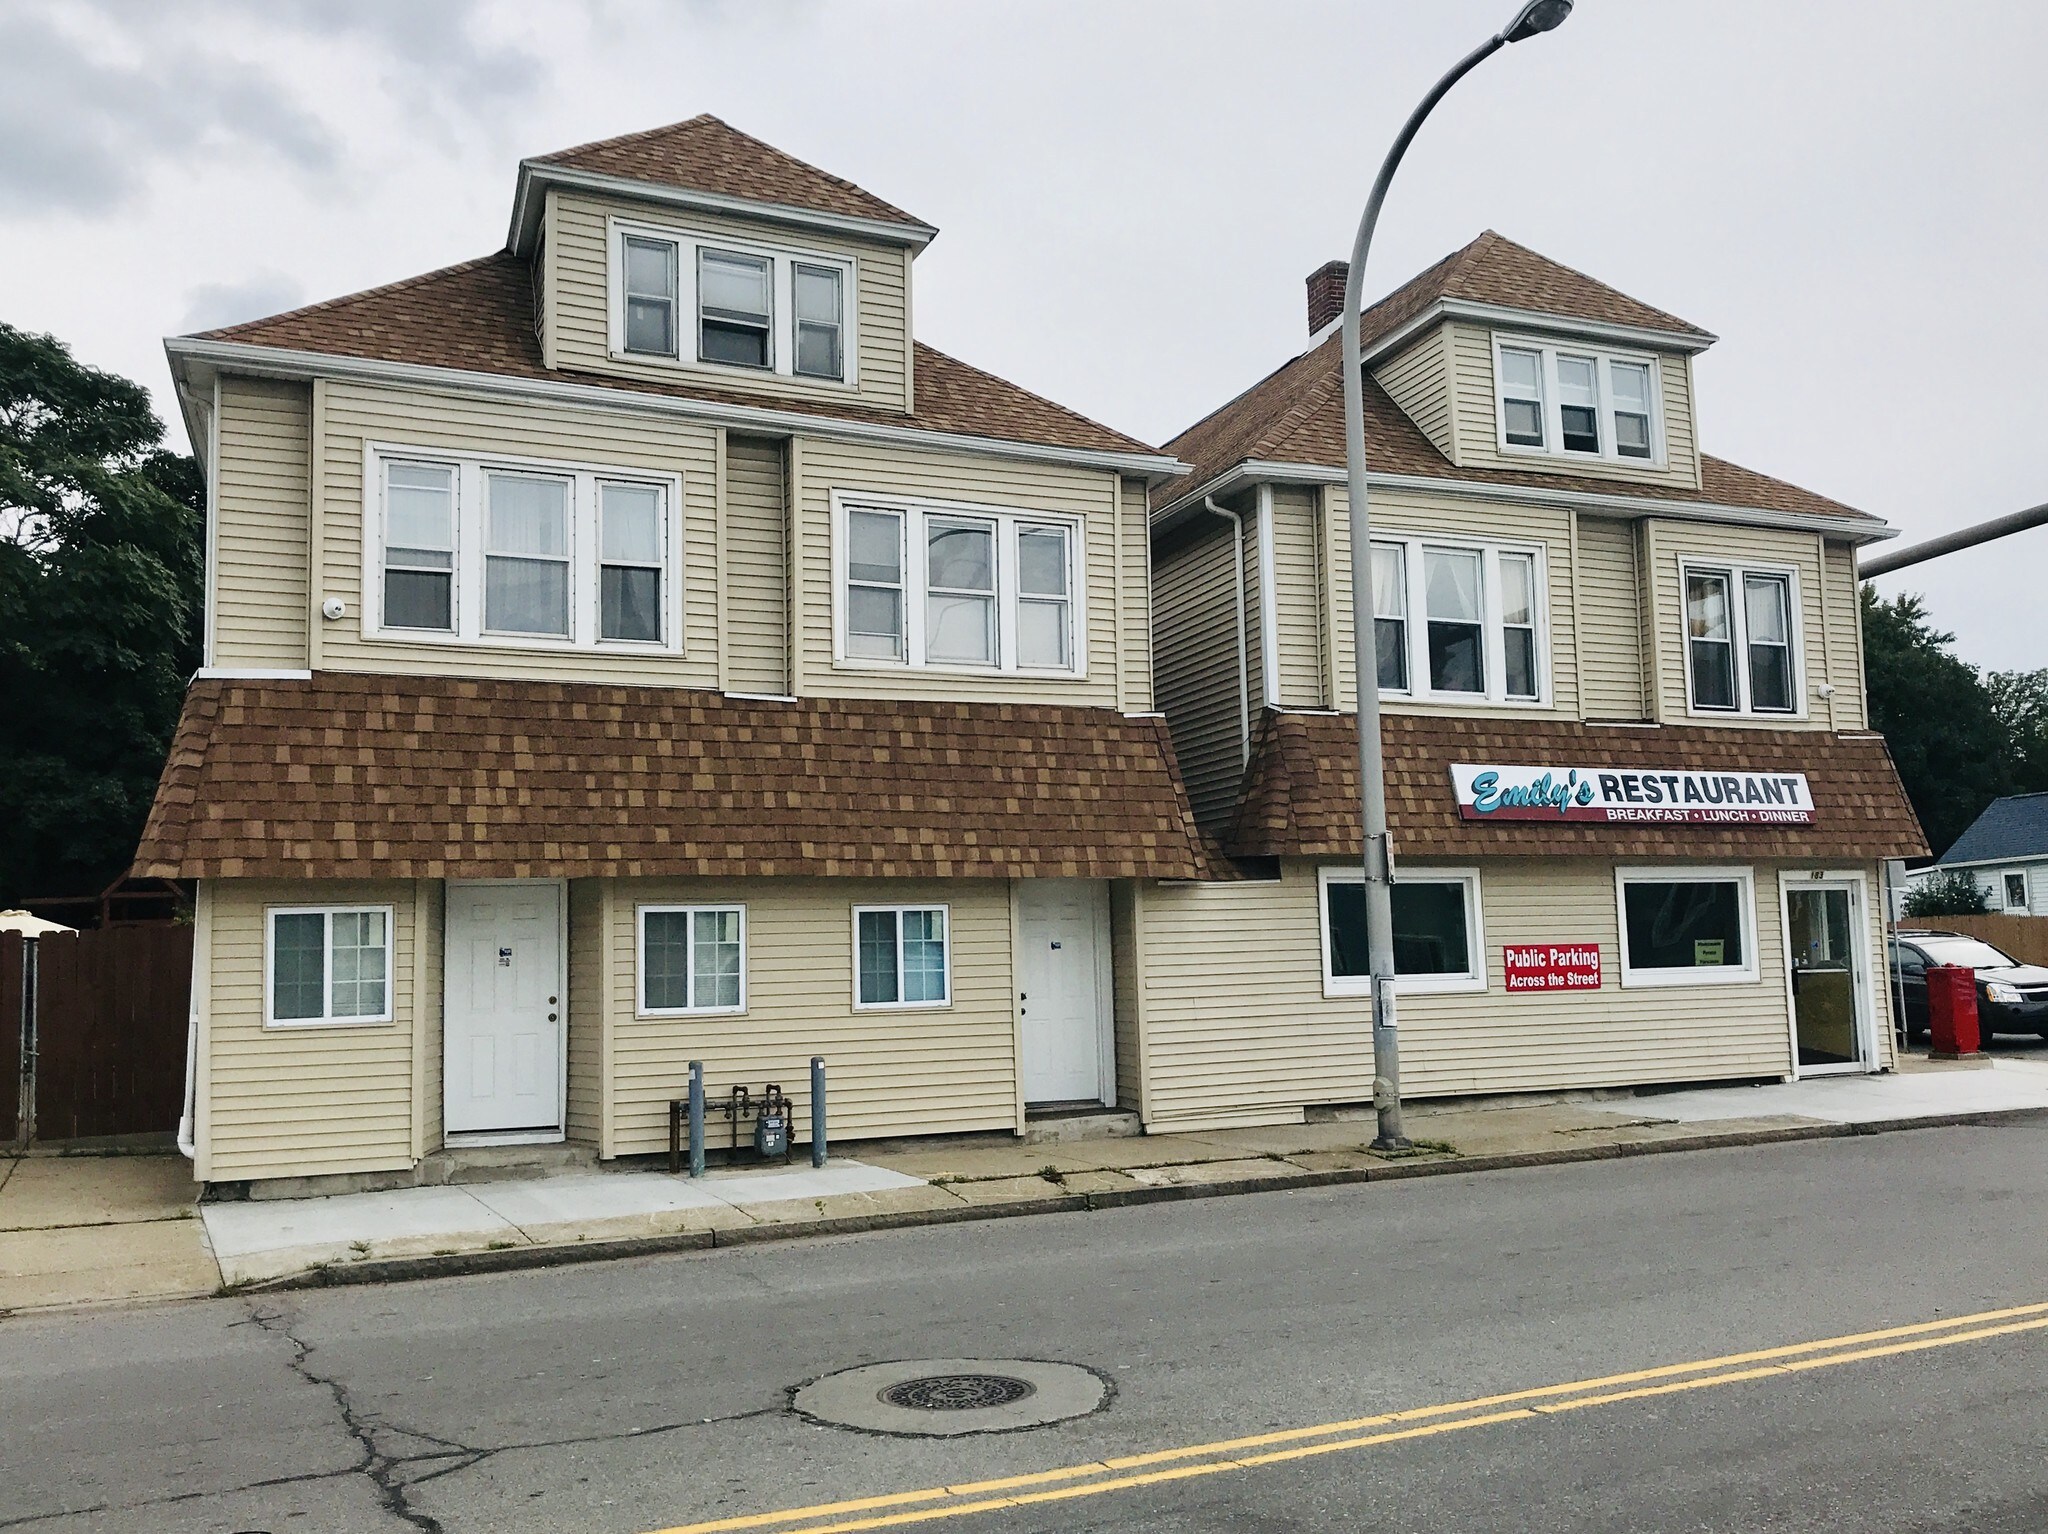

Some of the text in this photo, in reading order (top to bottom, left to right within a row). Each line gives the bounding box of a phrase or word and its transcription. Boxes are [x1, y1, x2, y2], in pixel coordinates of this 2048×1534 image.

[1471, 769, 1799, 815] Emily's RESTAURANT
[1606, 809, 1810, 823] BREAKFAST LUNCH DINNER
[1811, 871, 1824, 880] 183
[1506, 948, 1598, 970] Public Parking
[1509, 972, 1598, 987] Across the Street
